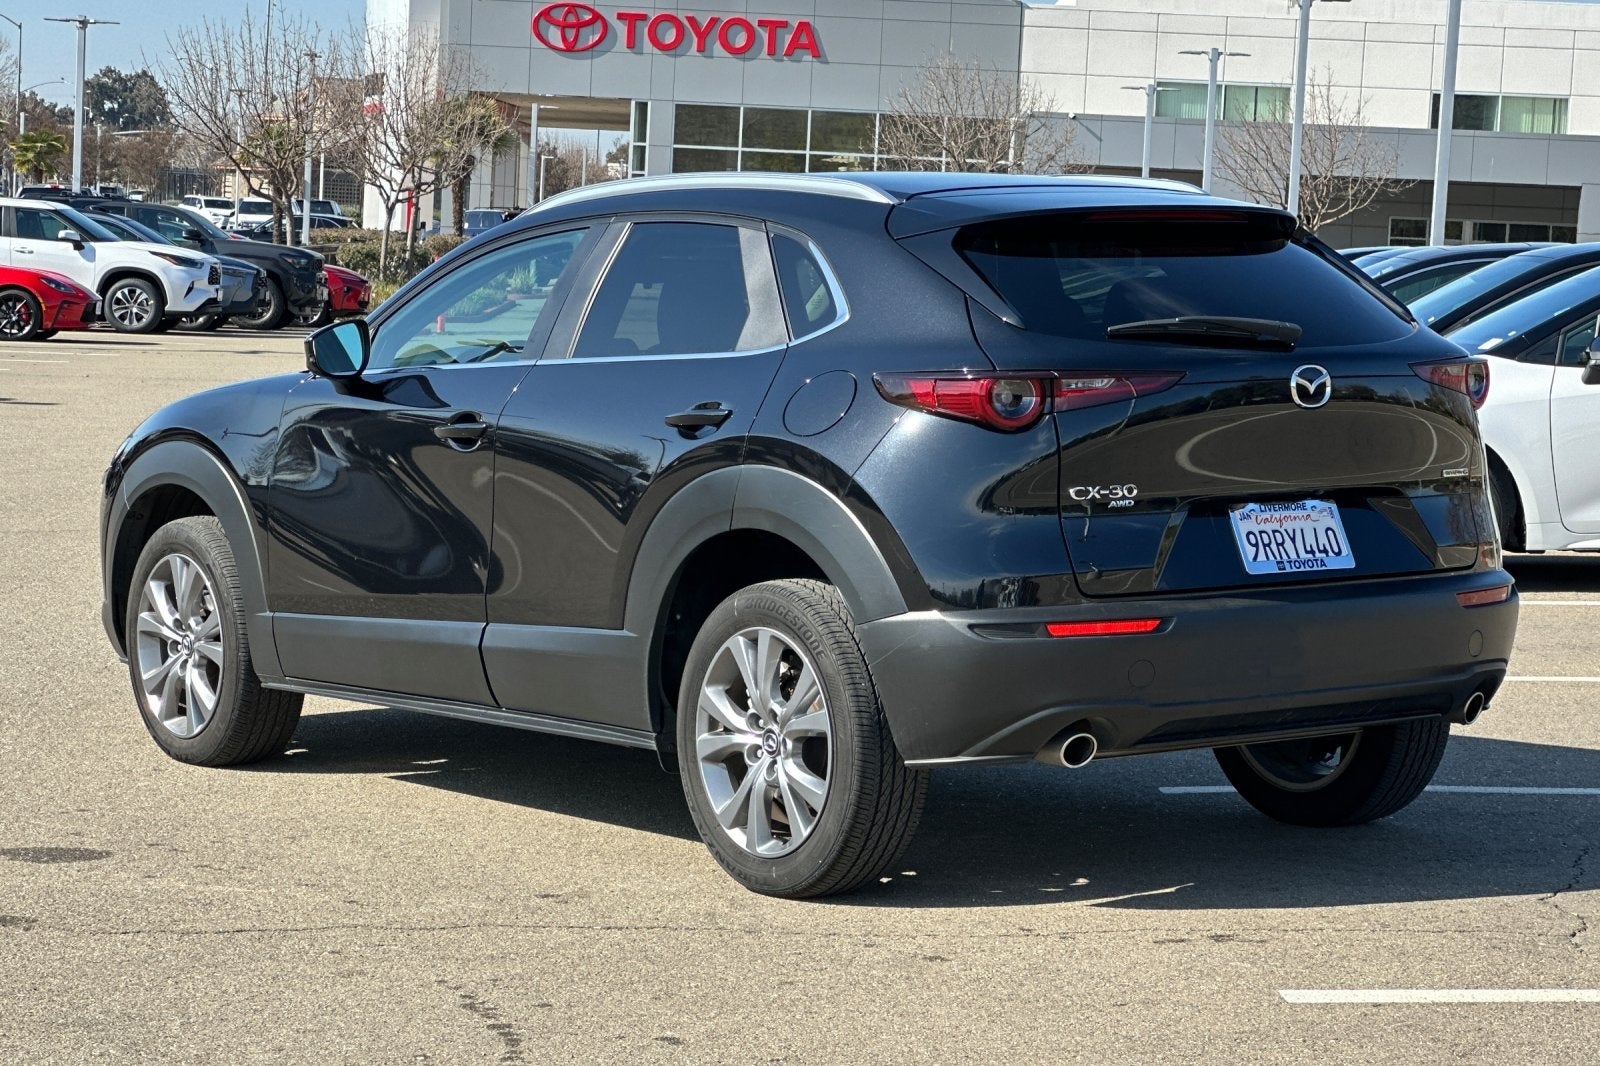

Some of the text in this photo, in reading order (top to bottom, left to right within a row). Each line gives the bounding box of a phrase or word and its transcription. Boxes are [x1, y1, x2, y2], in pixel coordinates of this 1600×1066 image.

[616, 12, 821, 58] TOYOTA
[1068, 483, 1138, 501] CX-30
[1107, 499, 1135, 508] AWD
[1259, 502, 1308, 513] LIVERMORE
[1238, 511, 1252, 521] JAN
[1255, 513, 1316, 528] California
[1245, 526, 1343, 562] 9RRY440
[1287, 558, 1328, 570] TOYOTA
[744, 598, 827, 660] BRIDGESTONE
